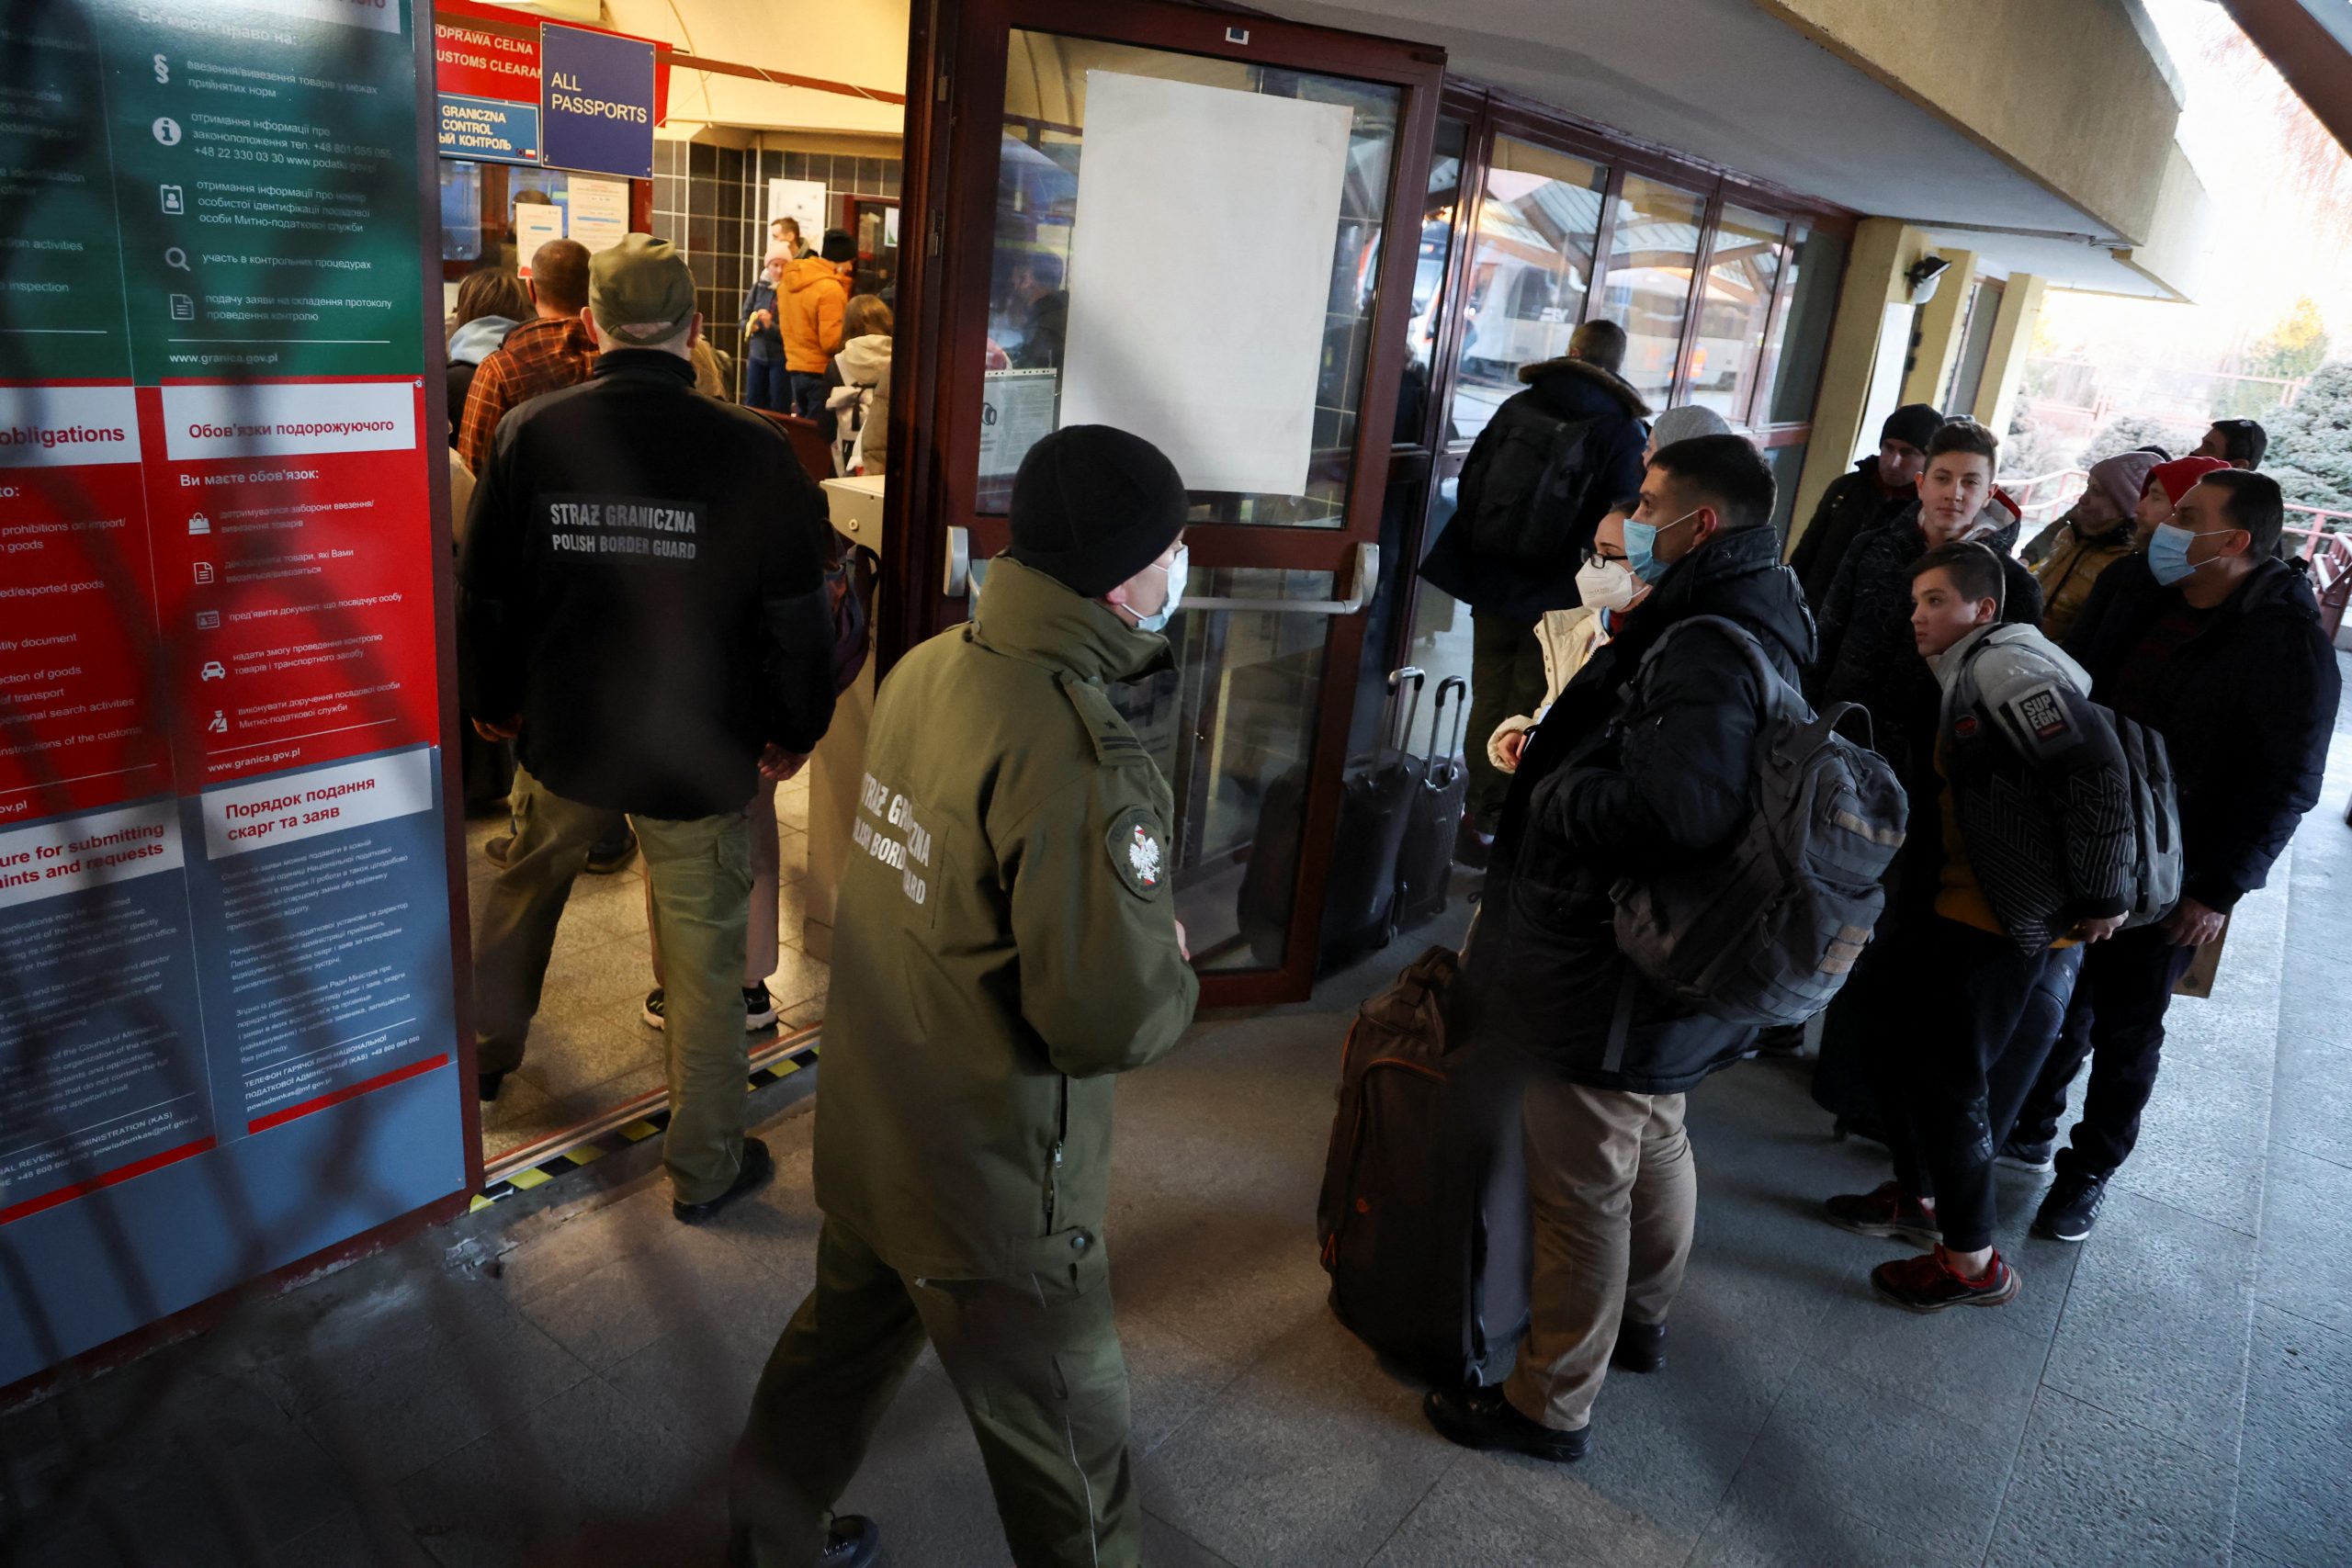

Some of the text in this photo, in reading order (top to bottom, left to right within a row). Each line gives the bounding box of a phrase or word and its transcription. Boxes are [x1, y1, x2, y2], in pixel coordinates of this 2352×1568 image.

[494, 37, 533, 55] CELNA
[436, 50, 487, 70] USTOMS
[188, 79, 276, 97] прийнятих норм
[551, 72, 582, 92] ALL
[442, 105, 506, 124] GRANICZNA
[551, 94, 648, 124] PASSPORTS
[191, 114, 331, 137] отримання інформації про
[442, 119, 493, 136] CONTROL
[314, 141, 332, 152] +48
[459, 135, 512, 151] КОНТРОЛЬ
[195, 145, 214, 156] +48
[218, 148, 230, 158] 22
[233, 149, 253, 160] 330
[255, 152, 268, 162] 03
[272, 152, 284, 163] 30
[197, 182, 334, 199] отримання інформації про
[198, 197, 251, 209] особистої
[199, 213, 232, 223] особи
[33, 240, 83, 251] activities
[202, 254, 238, 264] участь
[315, 259, 371, 270] процедурах
[9, 279, 69, 292] inspection
[345, 299, 391, 309] протоколу
[207, 311, 268, 320] проведення
[0, 424, 125, 447] obligations
[277, 421, 393, 436] подорожуючого
[180, 469, 318, 486] Ви маєте обов'язок:
[605, 504, 696, 534] GRANICZNA
[2, 523, 69, 536] prohibitions
[7, 539, 44, 553] goods
[332, 549, 354, 558] Вами
[552, 534, 696, 559] POLISH BORDER GUARD
[71, 580, 105, 592] goods
[379, 592, 401, 603] особу
[21, 633, 77, 647] document
[233, 649, 264, 660] надати
[266, 646, 290, 656] змогу
[33, 669, 44, 679] of
[48, 665, 81, 680] goods
[235, 662, 266, 674] товарів
[274, 654, 334, 670] транспортного
[15, 688, 64, 702] transport
[238, 701, 287, 715] виконувати
[288, 693, 333, 706] доручення
[377, 682, 400, 692] особи
[50, 704, 86, 717] search
[90, 698, 134, 711] activities
[318, 704, 347, 716] служби
[2023, 694, 2052, 716] SUP
[2030, 707, 2063, 730] EGN
[0, 738, 62, 753] nstructions
[64, 735, 74, 744] of
[78, 733, 95, 743] the
[208, 747, 300, 772] www.granica.gov.pl
[226, 778, 375, 818] Порядок подання
[228, 807, 340, 840] скарг та заяв
[36, 846, 62, 860] for
[68, 824, 164, 853] submitting
[46, 860, 80, 877] and
[85, 844, 164, 870] requests
[244, 1067, 281, 1088] ТЕЛЕФОН
[148, 1111, 173, 1127] (KAS)
